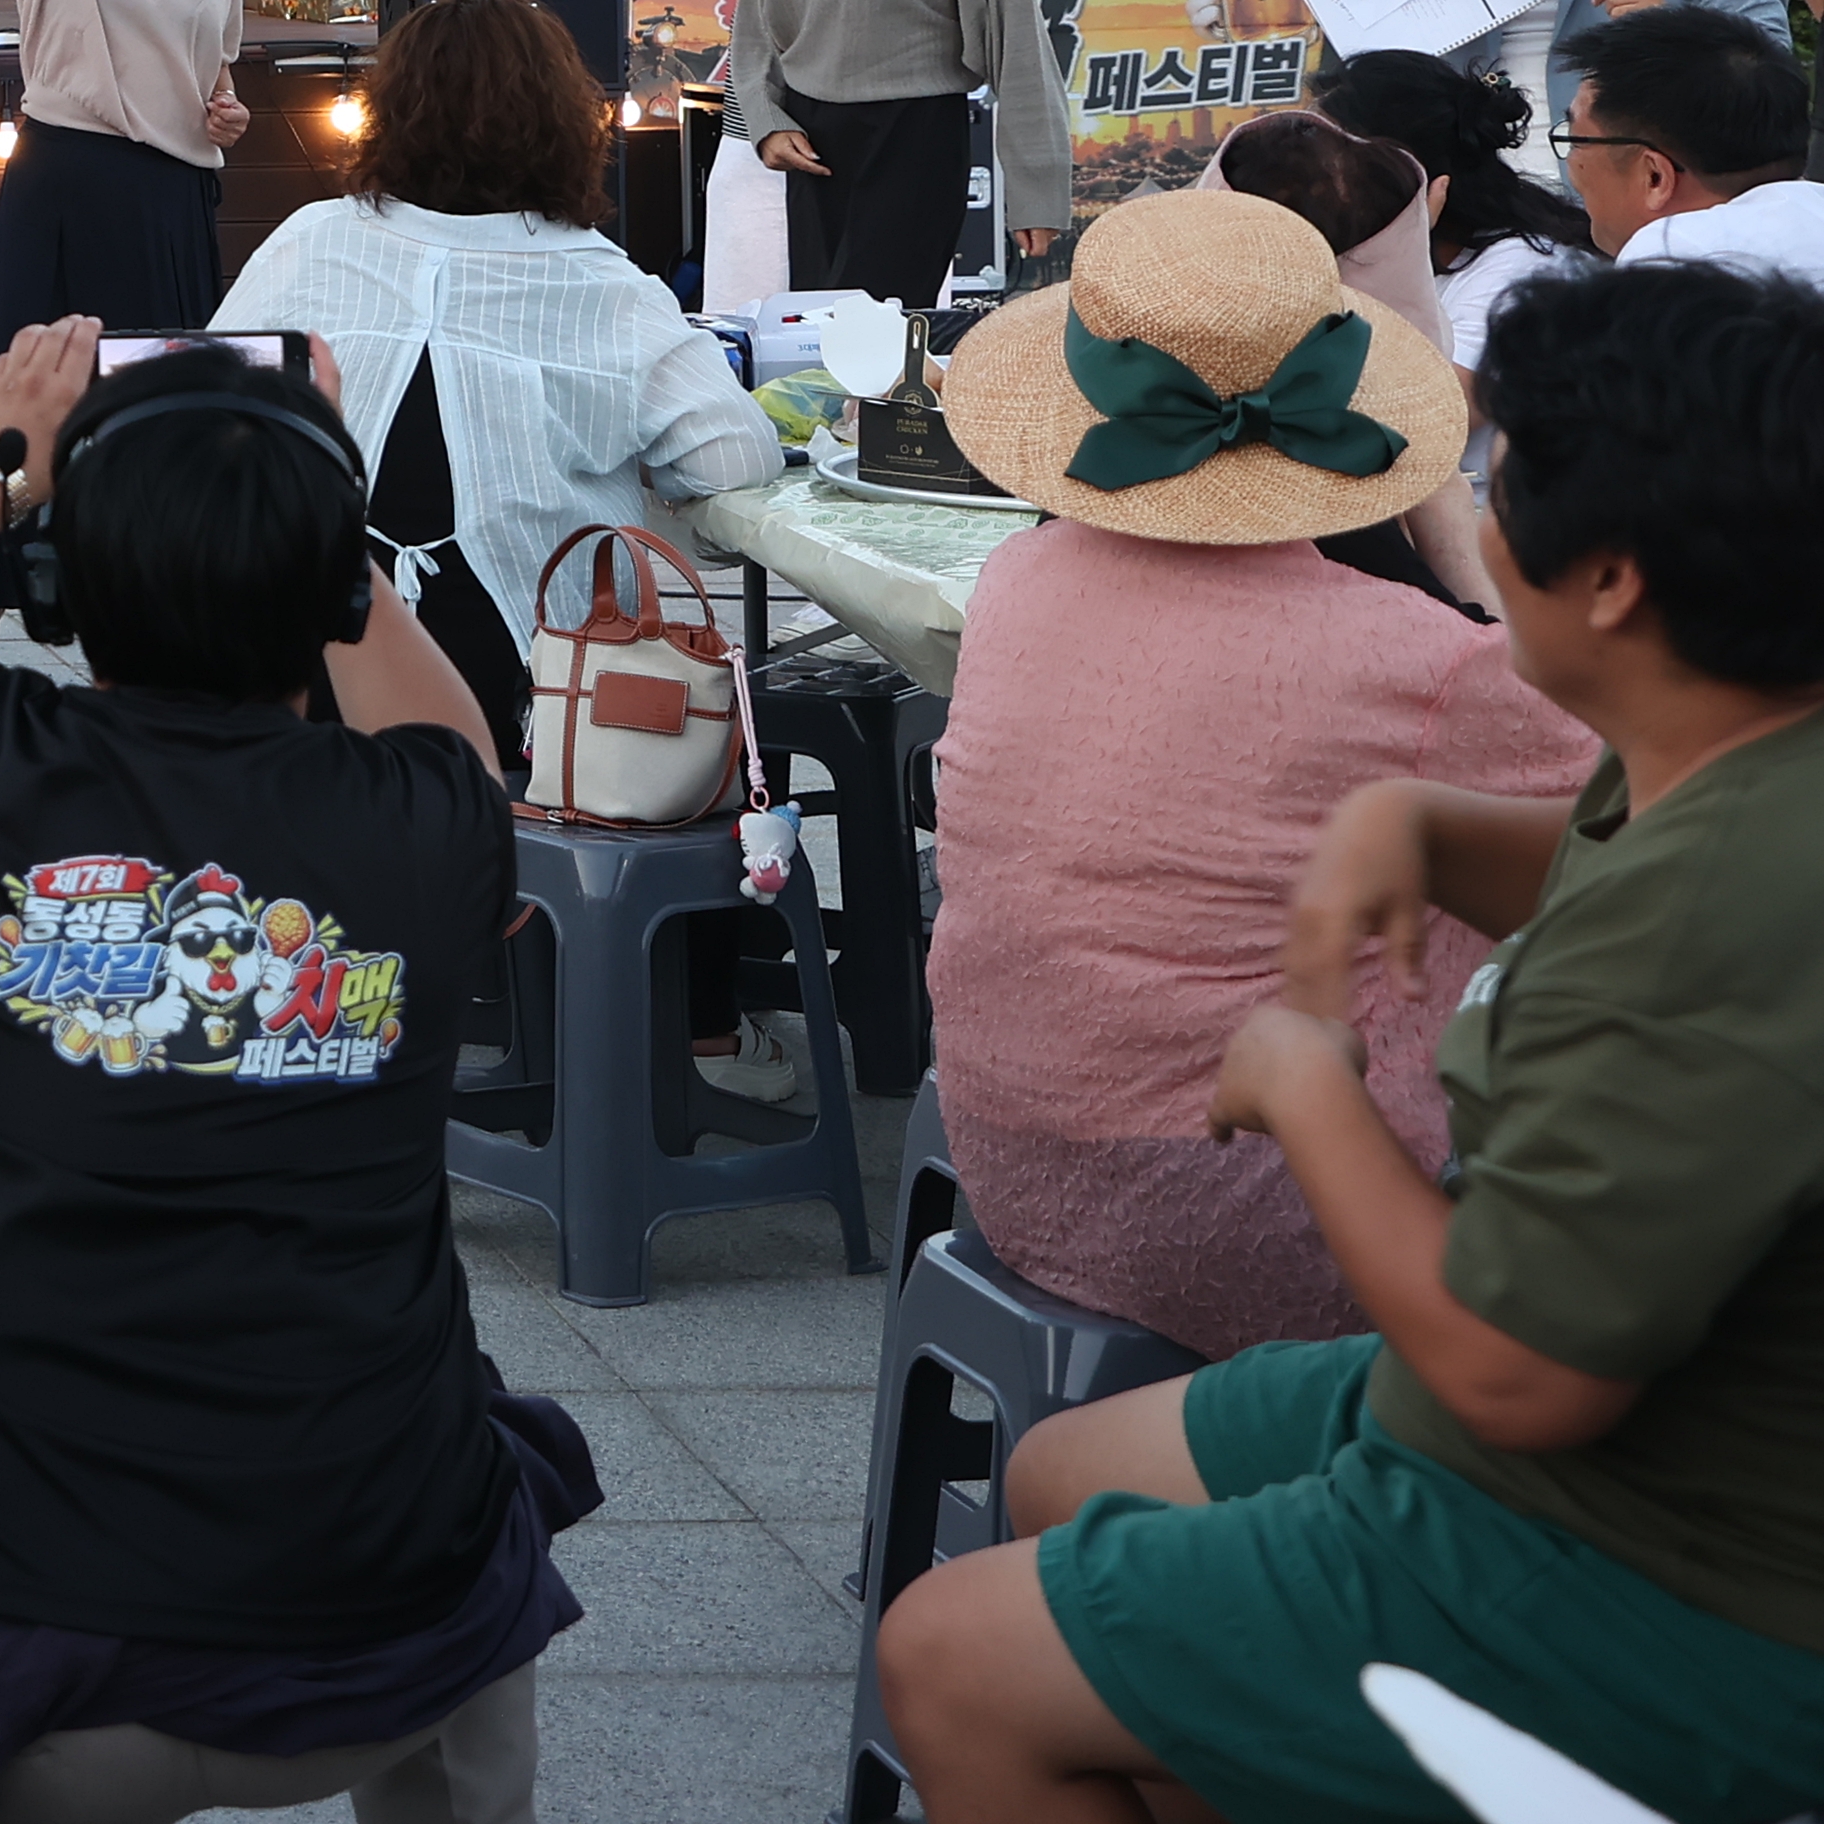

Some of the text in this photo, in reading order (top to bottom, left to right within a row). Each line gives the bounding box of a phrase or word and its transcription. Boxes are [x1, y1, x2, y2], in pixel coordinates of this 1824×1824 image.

[1084, 39, 1305, 114] 페스티벌
[48, 864, 129, 894] 제7회
[23, 897, 146, 942] 동성동
[264, 949, 404, 1039] 치맥
[237, 1037, 381, 1078] 페스티벌
